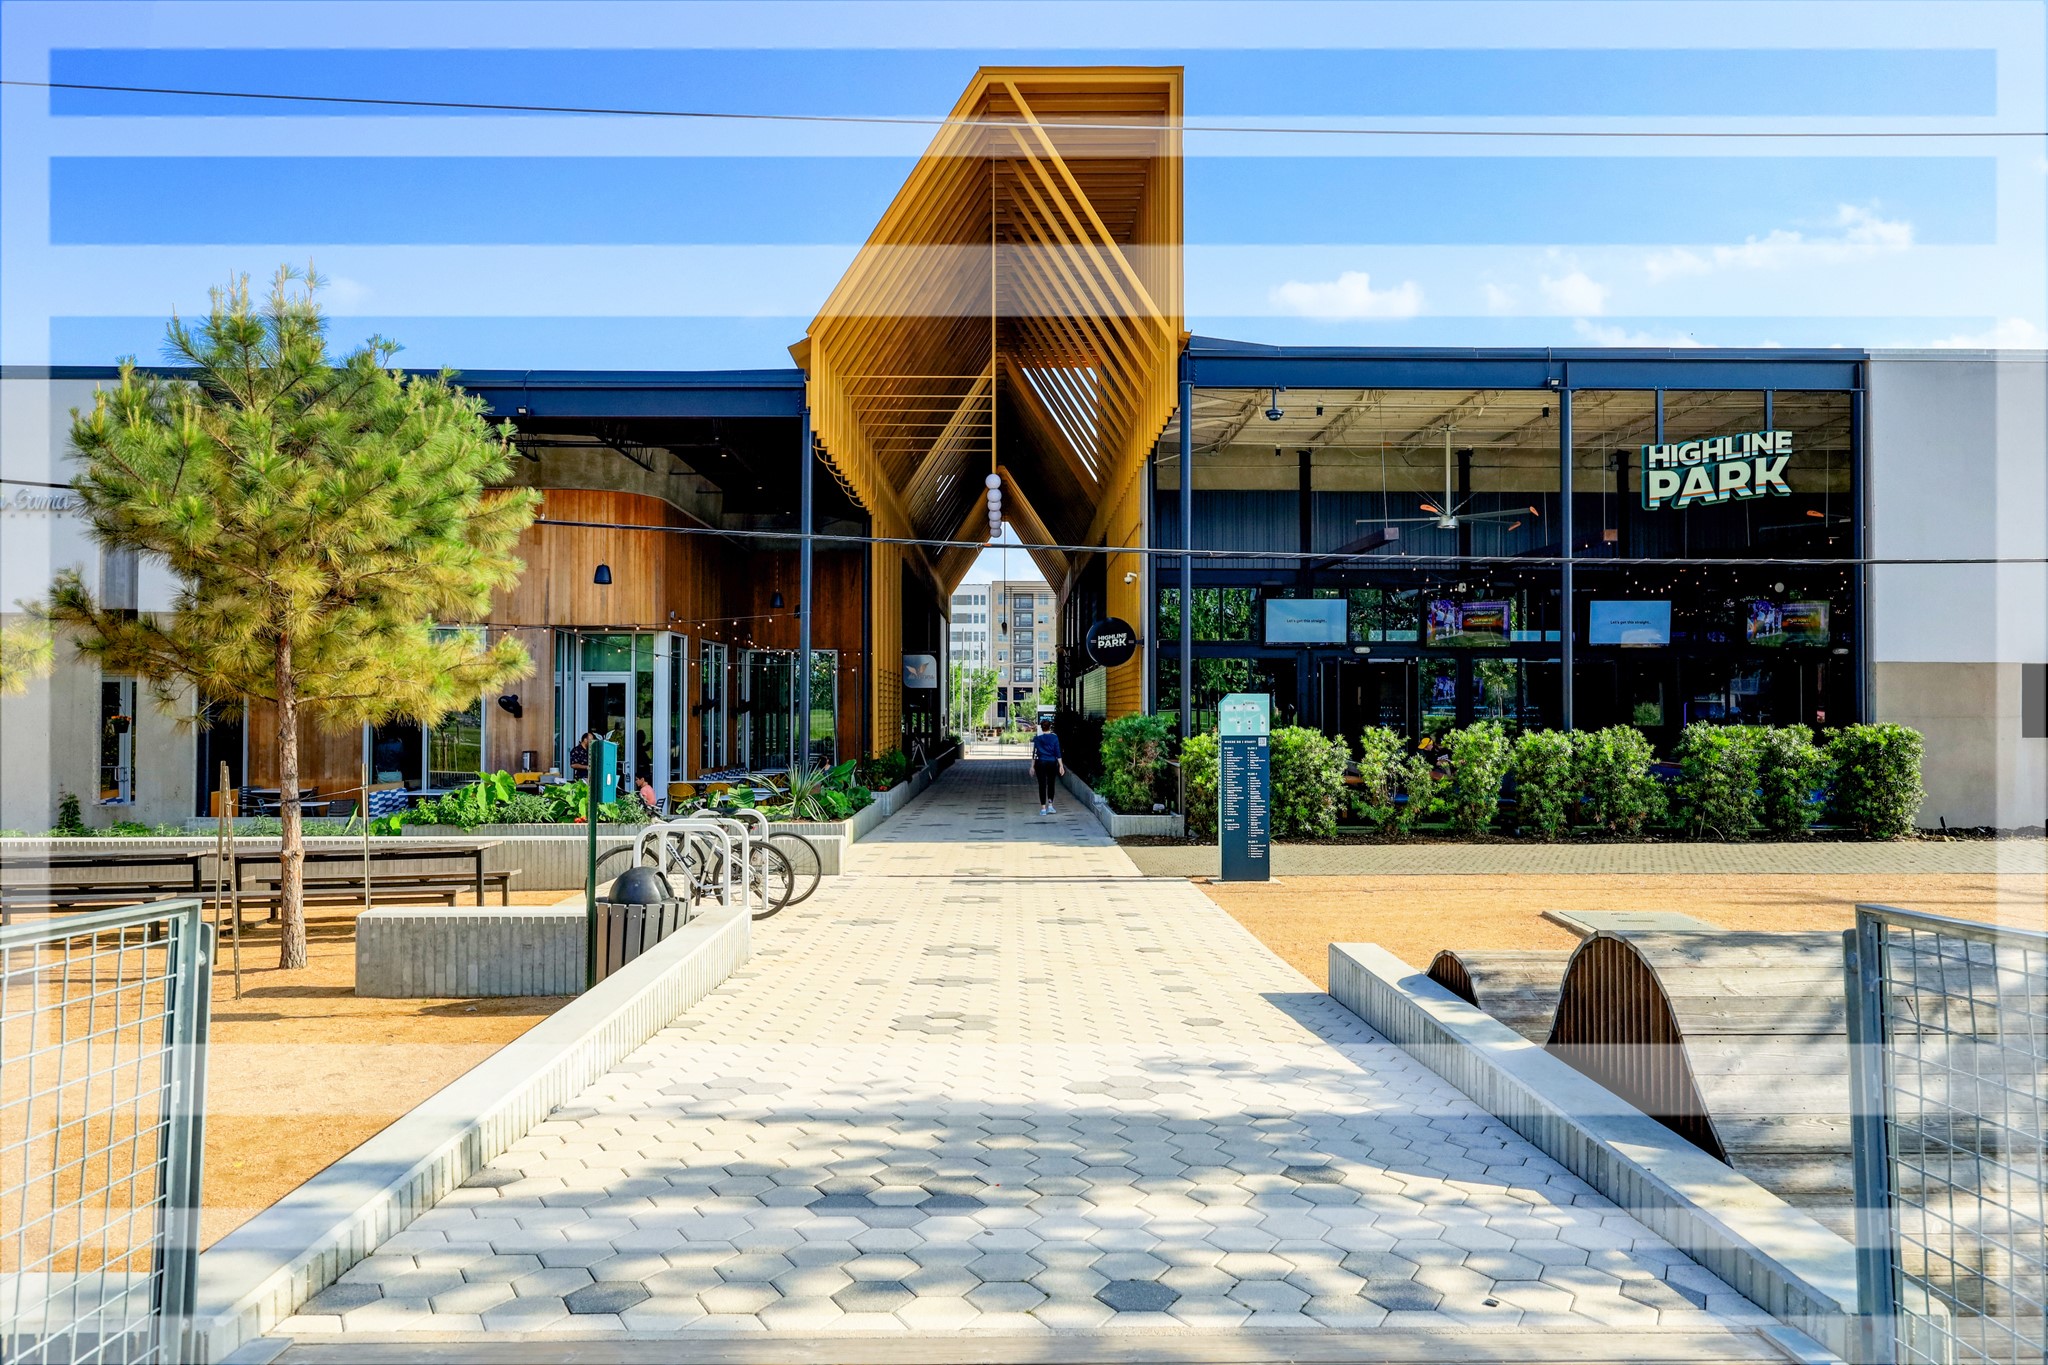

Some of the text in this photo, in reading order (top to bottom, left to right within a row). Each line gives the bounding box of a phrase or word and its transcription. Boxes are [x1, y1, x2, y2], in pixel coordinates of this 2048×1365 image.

[1646, 431, 1792, 468] HIGHLINE
[1646, 456, 1792, 509] PARK
[1098, 633, 1127, 641] HIGHLINE
[1098, 639, 1126, 648] PARK
[1062, 649, 1071, 686] MENDO
